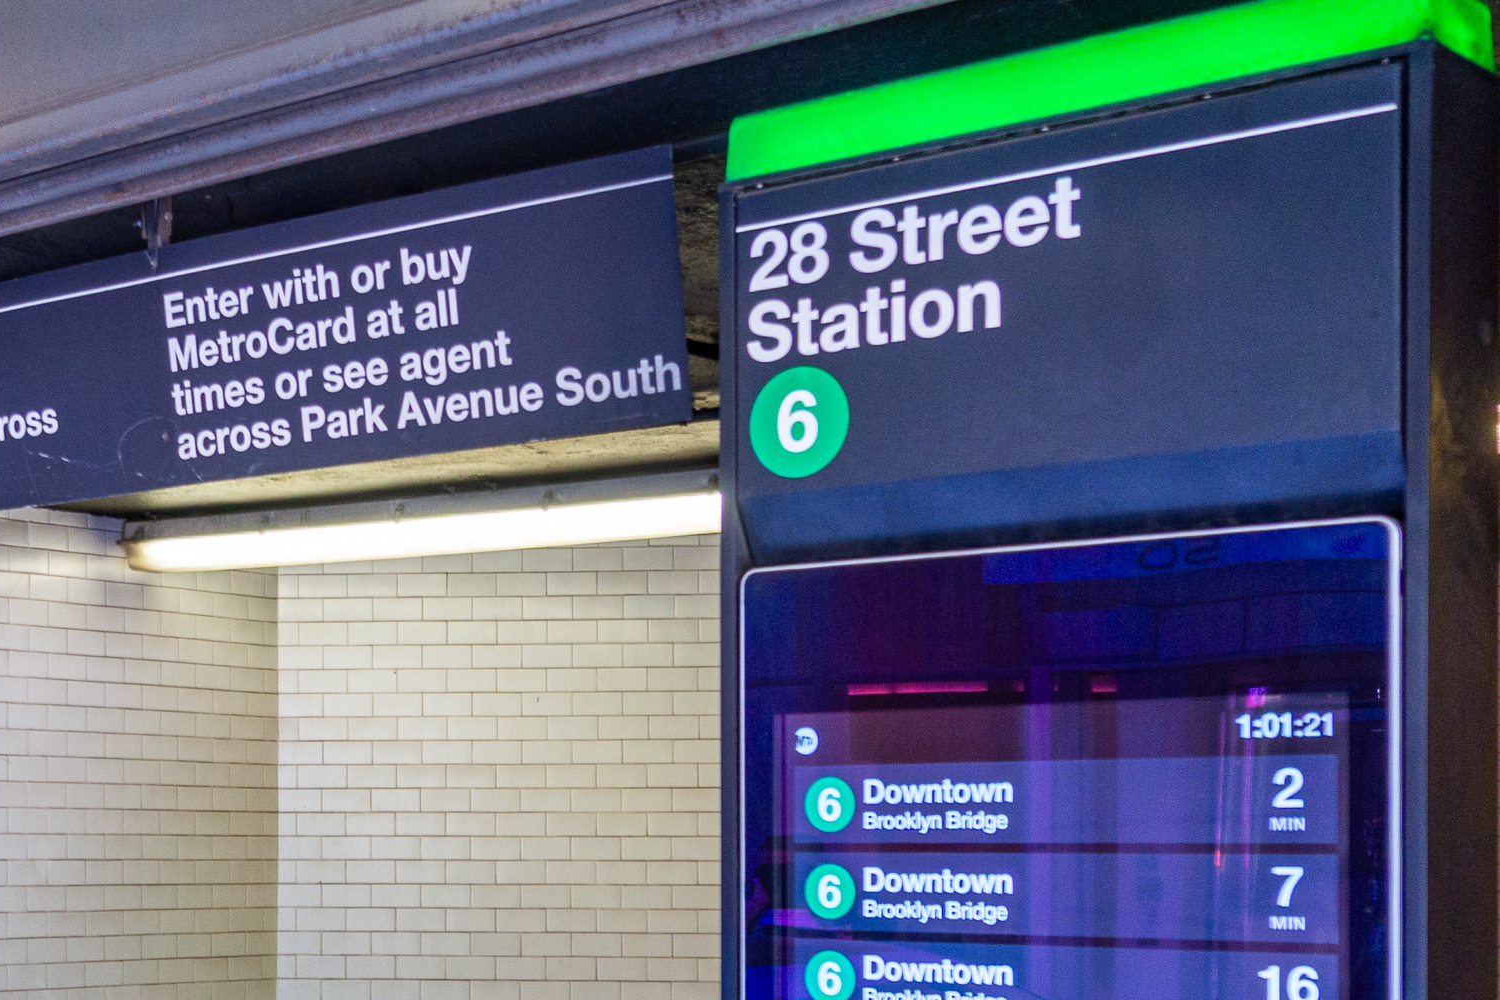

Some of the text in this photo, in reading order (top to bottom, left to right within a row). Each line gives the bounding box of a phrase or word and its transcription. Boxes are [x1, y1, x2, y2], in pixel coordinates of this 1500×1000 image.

[749, 176, 1082, 292] 28 Street
[163, 245, 472, 329] Enter with or buy
[168, 289, 459, 372] MetroCard at all
[746, 279, 1002, 363] Station
[172, 331, 512, 416] times or see agent
[177, 354, 682, 460] across Park Avenue South
[776, 389, 818, 453] 6
[1235, 711, 1334, 739] 1:01:21
[817, 787, 841, 822] 6
[863, 778, 1014, 805] Downtown
[1272, 767, 1304, 808] 2
[862, 810, 1009, 834] Brooklyn Bridge
[1268, 817, 1306, 832] MIN
[817, 874, 841, 909] 6
[863, 866, 1014, 895] Downtown
[1271, 866, 1304, 907] 7
[862, 899, 1009, 926] Brooklyn Bridge
[1268, 916, 1306, 931] MIN
[817, 960, 841, 996] 6
[863, 954, 1014, 986] Downtown
